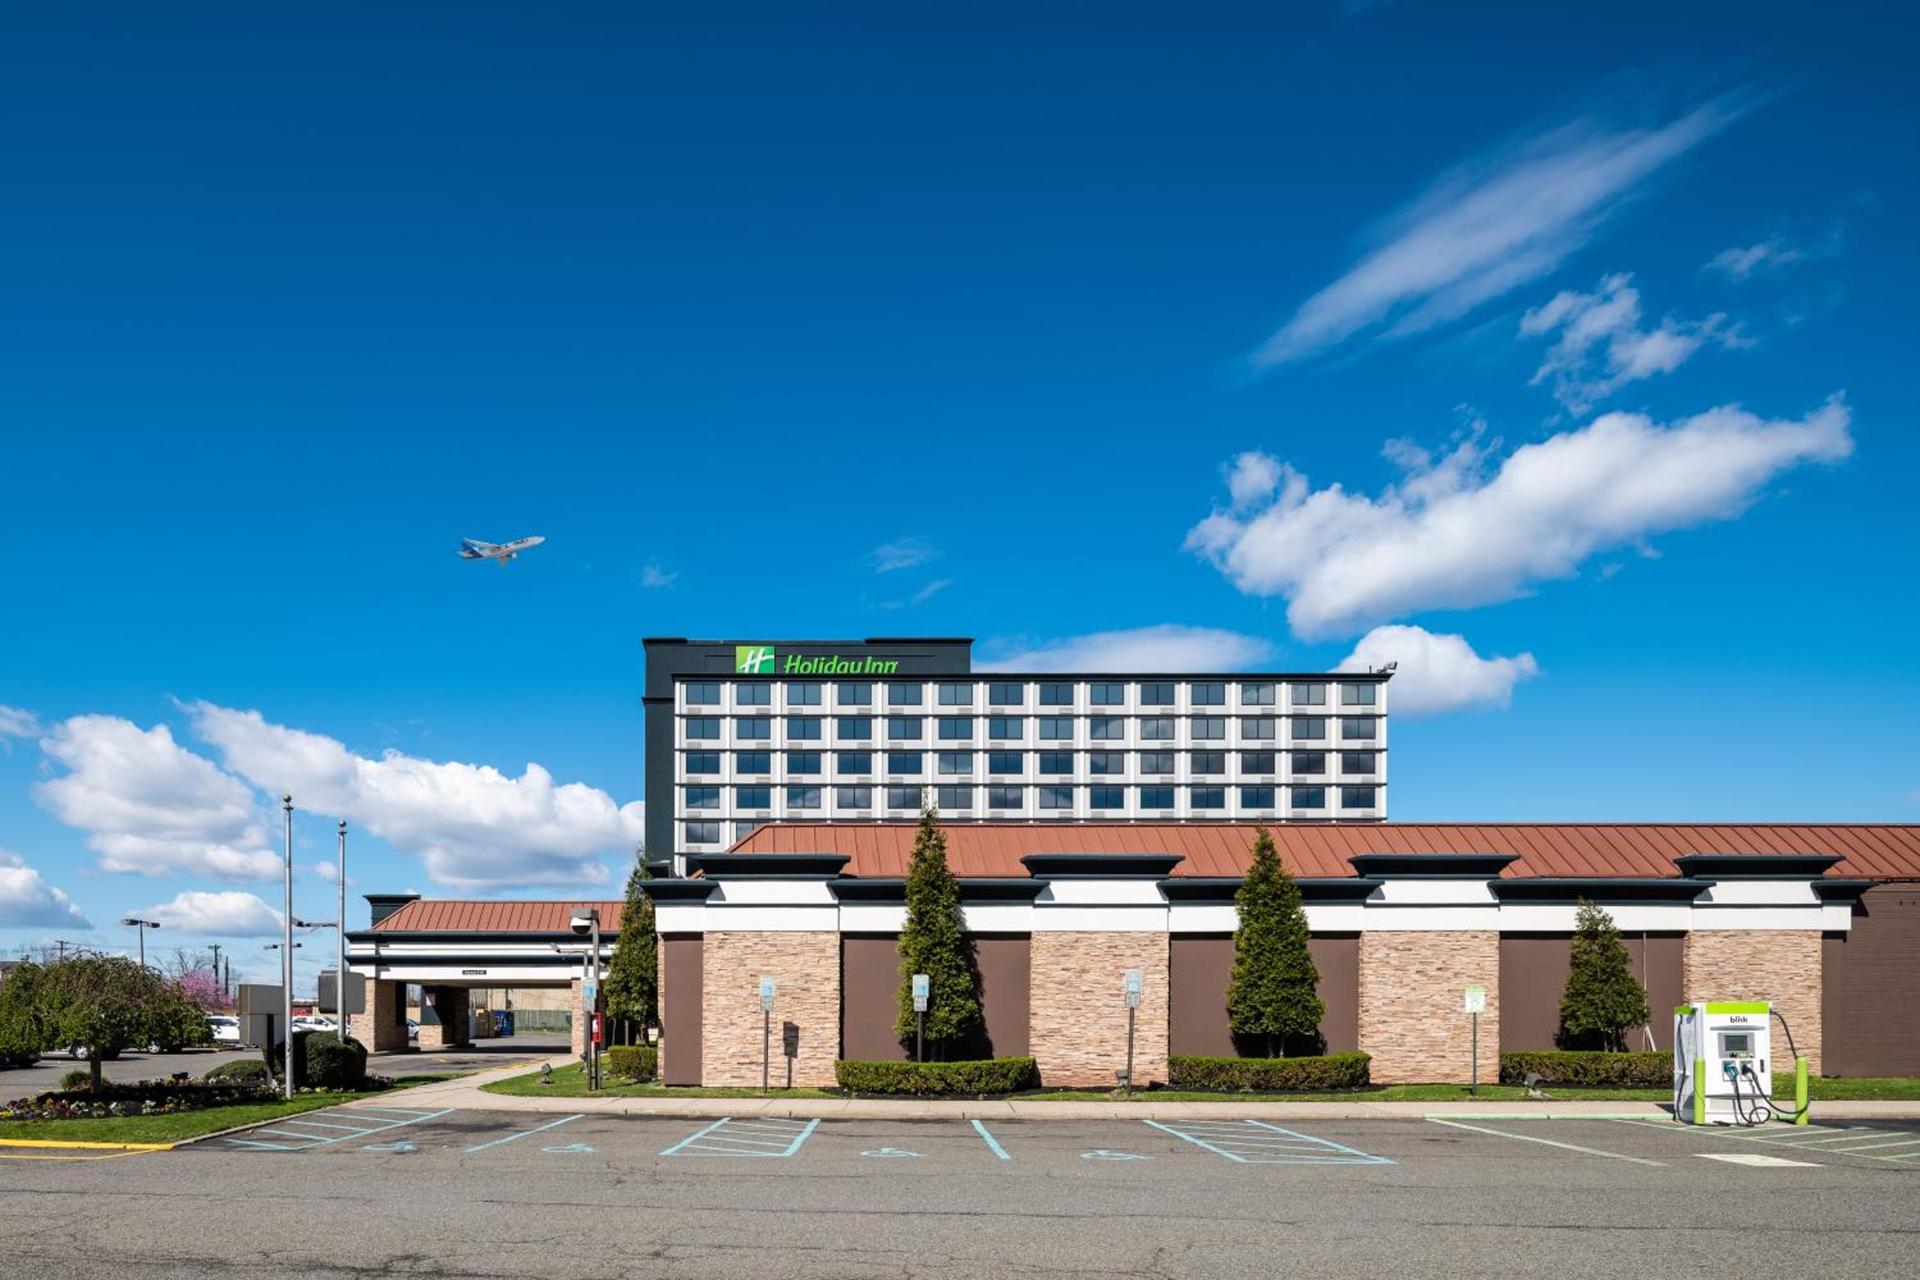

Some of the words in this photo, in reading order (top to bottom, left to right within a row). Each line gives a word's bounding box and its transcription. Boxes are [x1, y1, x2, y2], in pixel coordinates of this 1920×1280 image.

[784, 655, 862, 674] Holiday
[864, 656, 898, 674] Inn
[1730, 1015, 1748, 1024] blink
